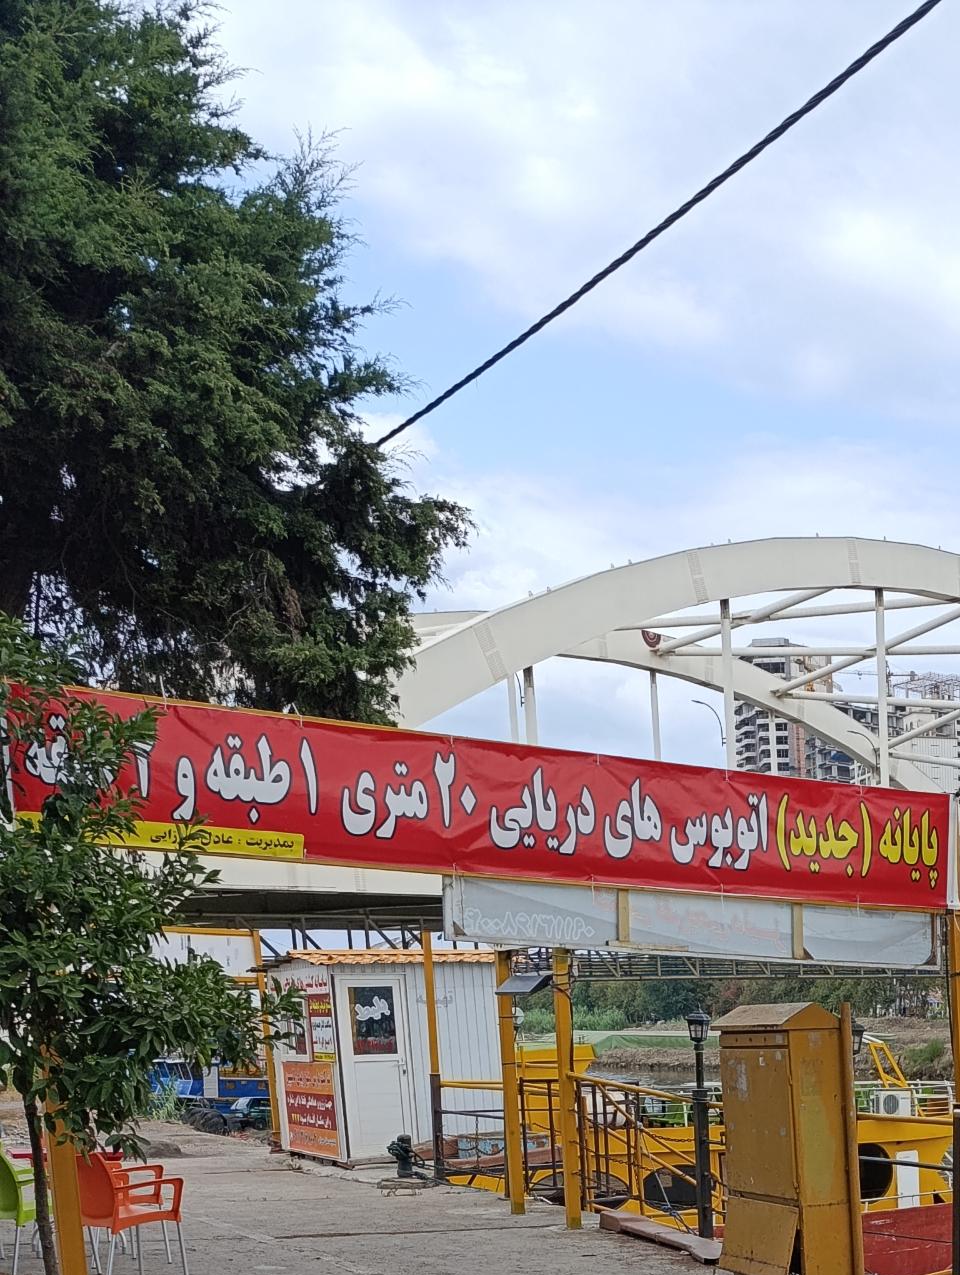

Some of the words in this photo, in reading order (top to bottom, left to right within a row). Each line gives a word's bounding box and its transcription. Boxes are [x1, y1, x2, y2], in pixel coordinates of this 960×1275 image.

[172, 756, 196, 821] و
[205, 733, 292, 824] طبقه
[342, 762, 429, 839] متری
[433, 752, 477, 829] ۲۰
[489, 765, 596, 855] دریایی
[604, 777, 662, 859] های
[245, 838, 295, 852] بمدیریت
[670, 792, 768, 870] اتوبوس
[776, 793, 873, 877] (جدید)
[878, 805, 940, 889] پایانه
